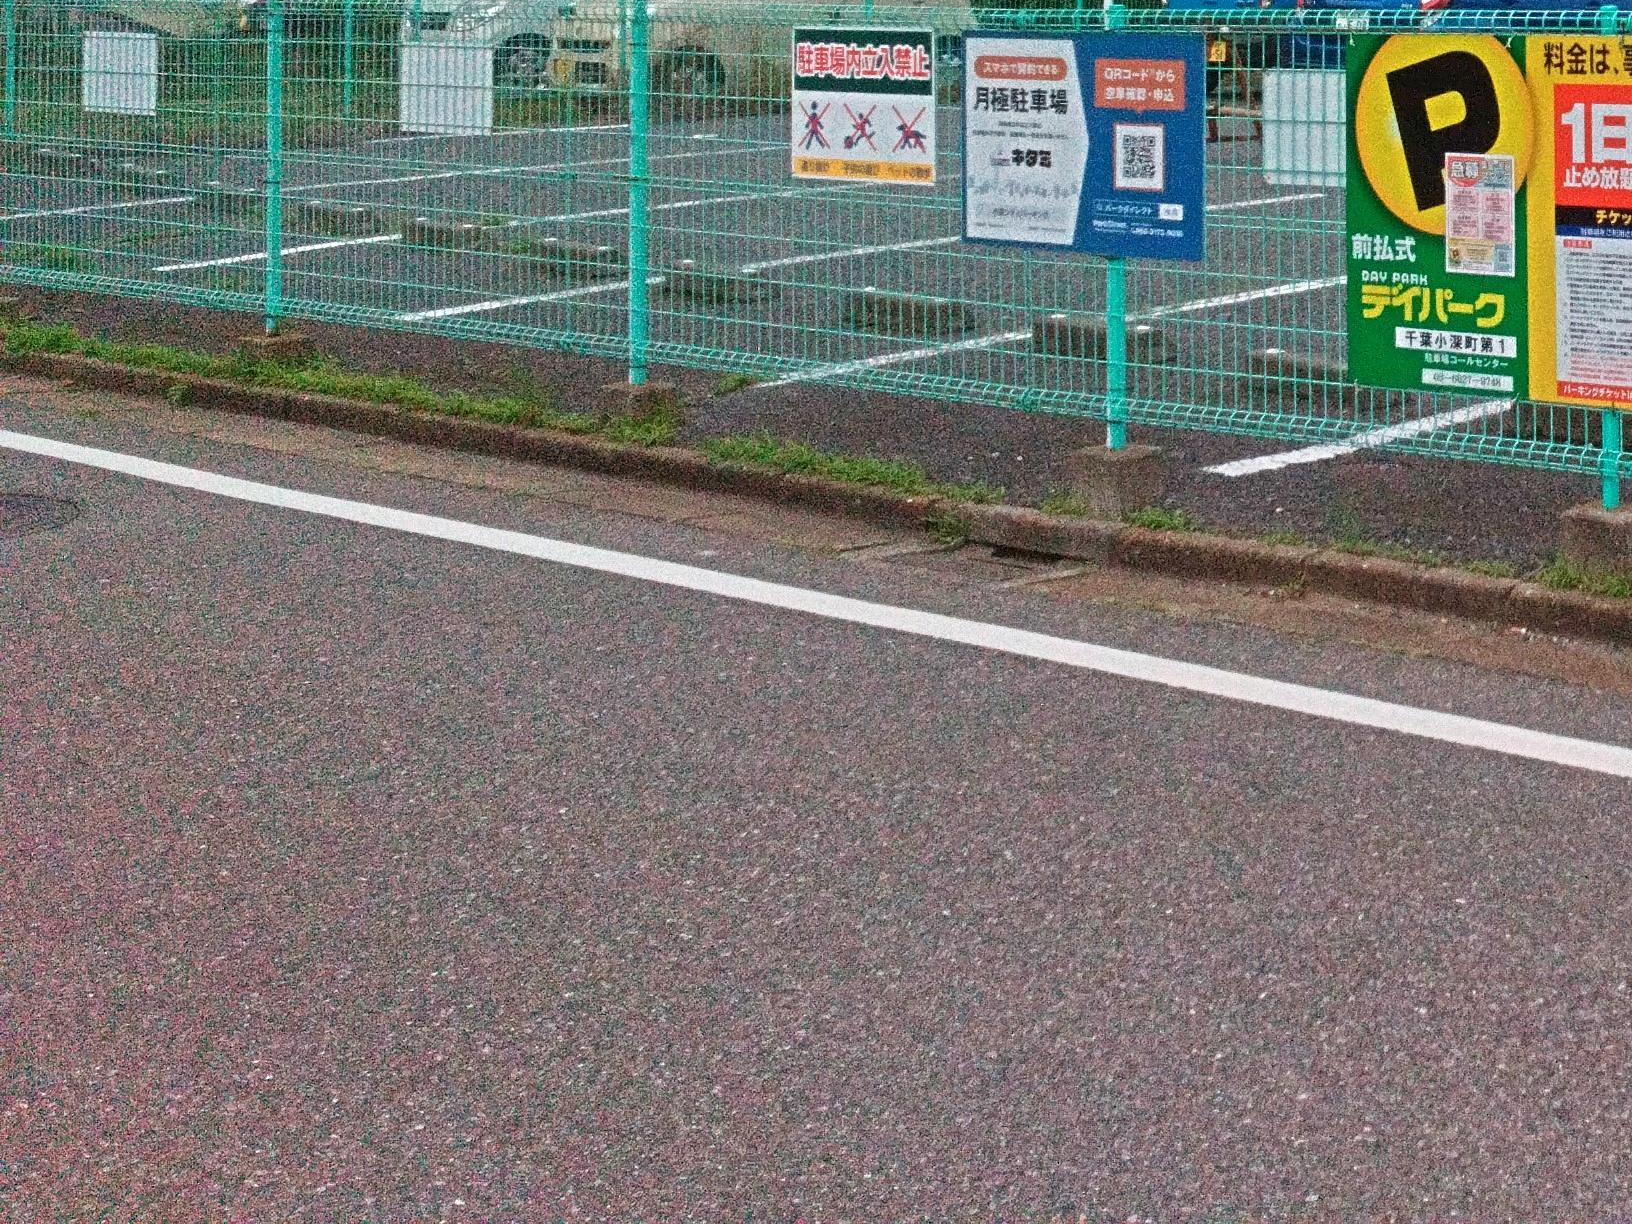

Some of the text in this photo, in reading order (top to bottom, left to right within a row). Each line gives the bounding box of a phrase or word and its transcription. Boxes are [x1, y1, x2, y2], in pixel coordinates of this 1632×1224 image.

[797, 42, 931, 80] 駐車場内立入禁止
[973, 87, 1069, 115] 月極駐車場
[1386, 50, 1501, 212] P
[1351, 233, 1416, 262] 前払式
[1362, 270, 1428, 286] DAY PARK
[1361, 283, 1505, 328] デイパーク
[1424, 353, 1509, 369] 駐車場コールセンター
